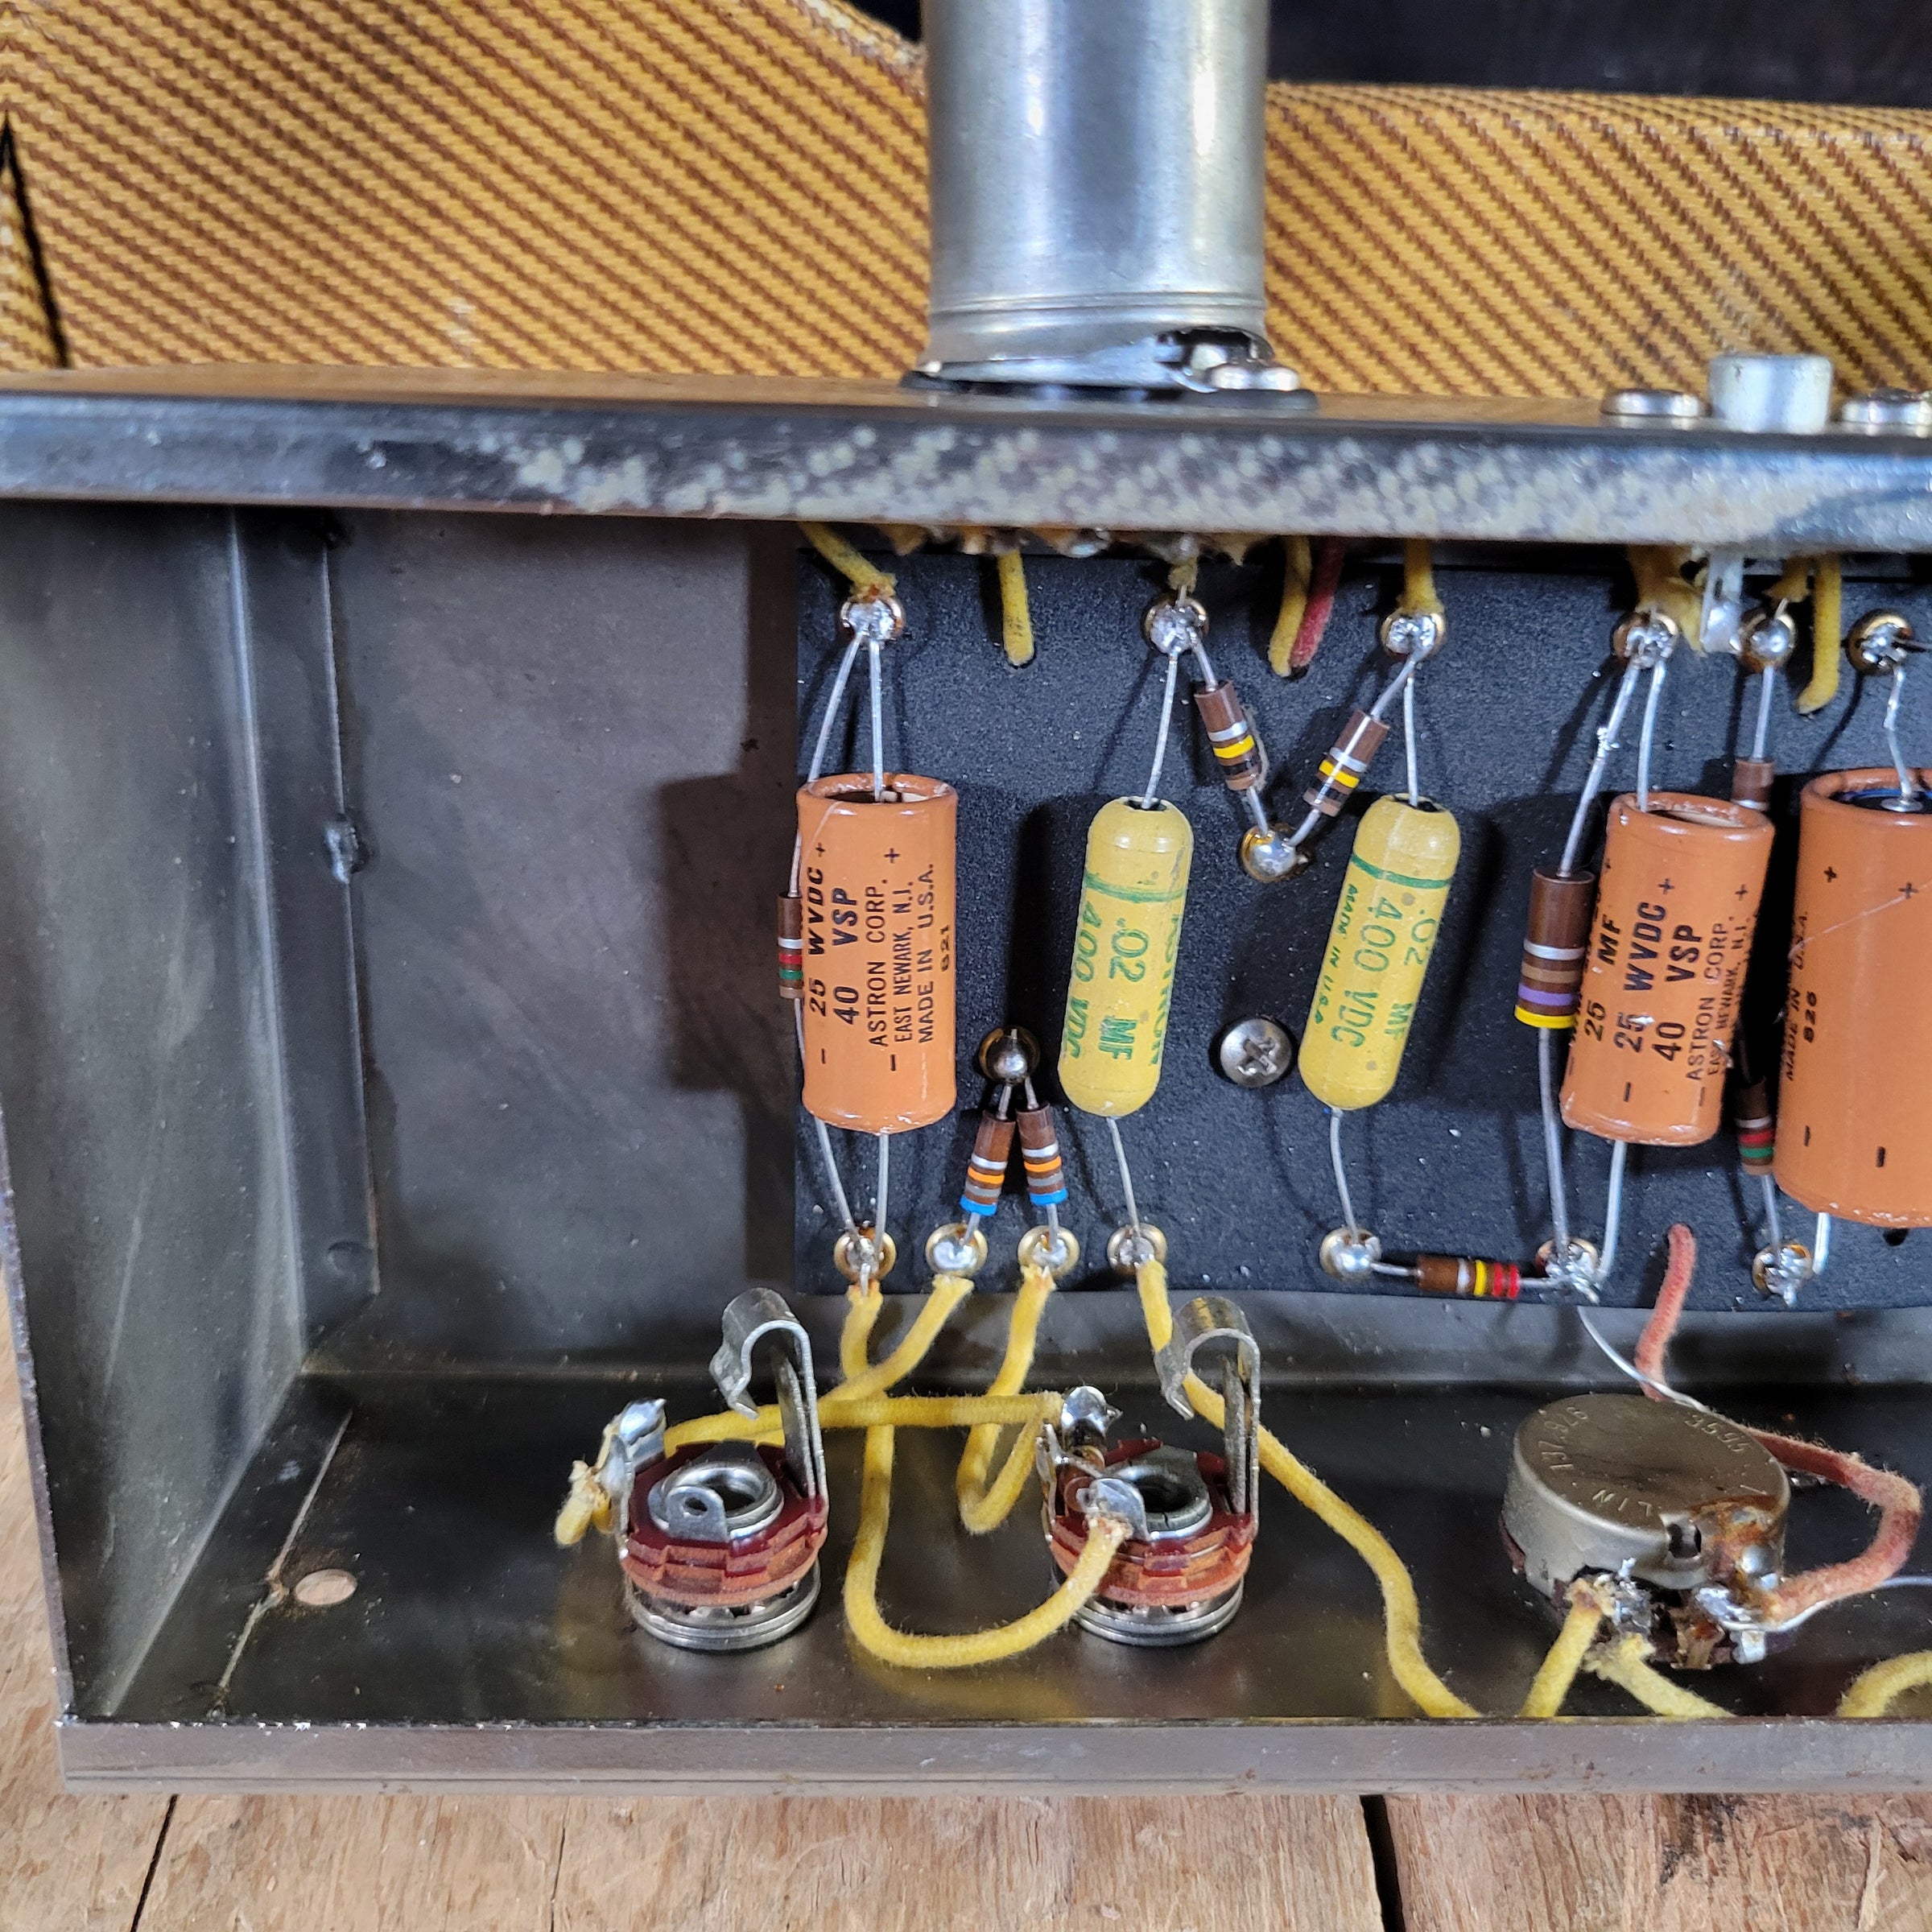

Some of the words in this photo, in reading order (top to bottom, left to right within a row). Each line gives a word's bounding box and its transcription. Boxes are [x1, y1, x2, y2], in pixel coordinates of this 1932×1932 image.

[807, 867, 825, 955] WVDC
[832, 888, 857, 946] VSP
[865, 879, 888, 943] CORP.
[917, 864, 935, 929] U.S.A.
[893, 927, 914, 996] NEWARK,
[916, 948, 934, 972] IN
[1075, 900, 1101, 983] 400
[1353, 896, 1403, 972] 400
[1623, 901, 1666, 992] WVDC
[1664, 924, 1703, 983] VSP
[809, 978, 826, 1017] 25
[833, 986, 860, 1025] 40
[866, 961, 889, 1046] ASTRON
[1584, 998, 1607, 1042] 25
[1597, 914, 1621, 966] MF
[1686, 997, 1715, 1081] ASTRON
[1703, 915, 1735, 983] CORP.
[1790, 988, 1802, 1012] IN
[894, 1006, 913, 1042] EAST
[918, 980, 935, 1043] MADE
[1098, 1014, 1137, 1060] MF
[1330, 989, 1379, 1047] VDC
[1612, 1011, 1648, 1054] 25
[1651, 1021, 1686, 1062] 40
[1707, 1040, 1726, 1075] EAS
[1785, 1022, 1798, 1081] MADE
